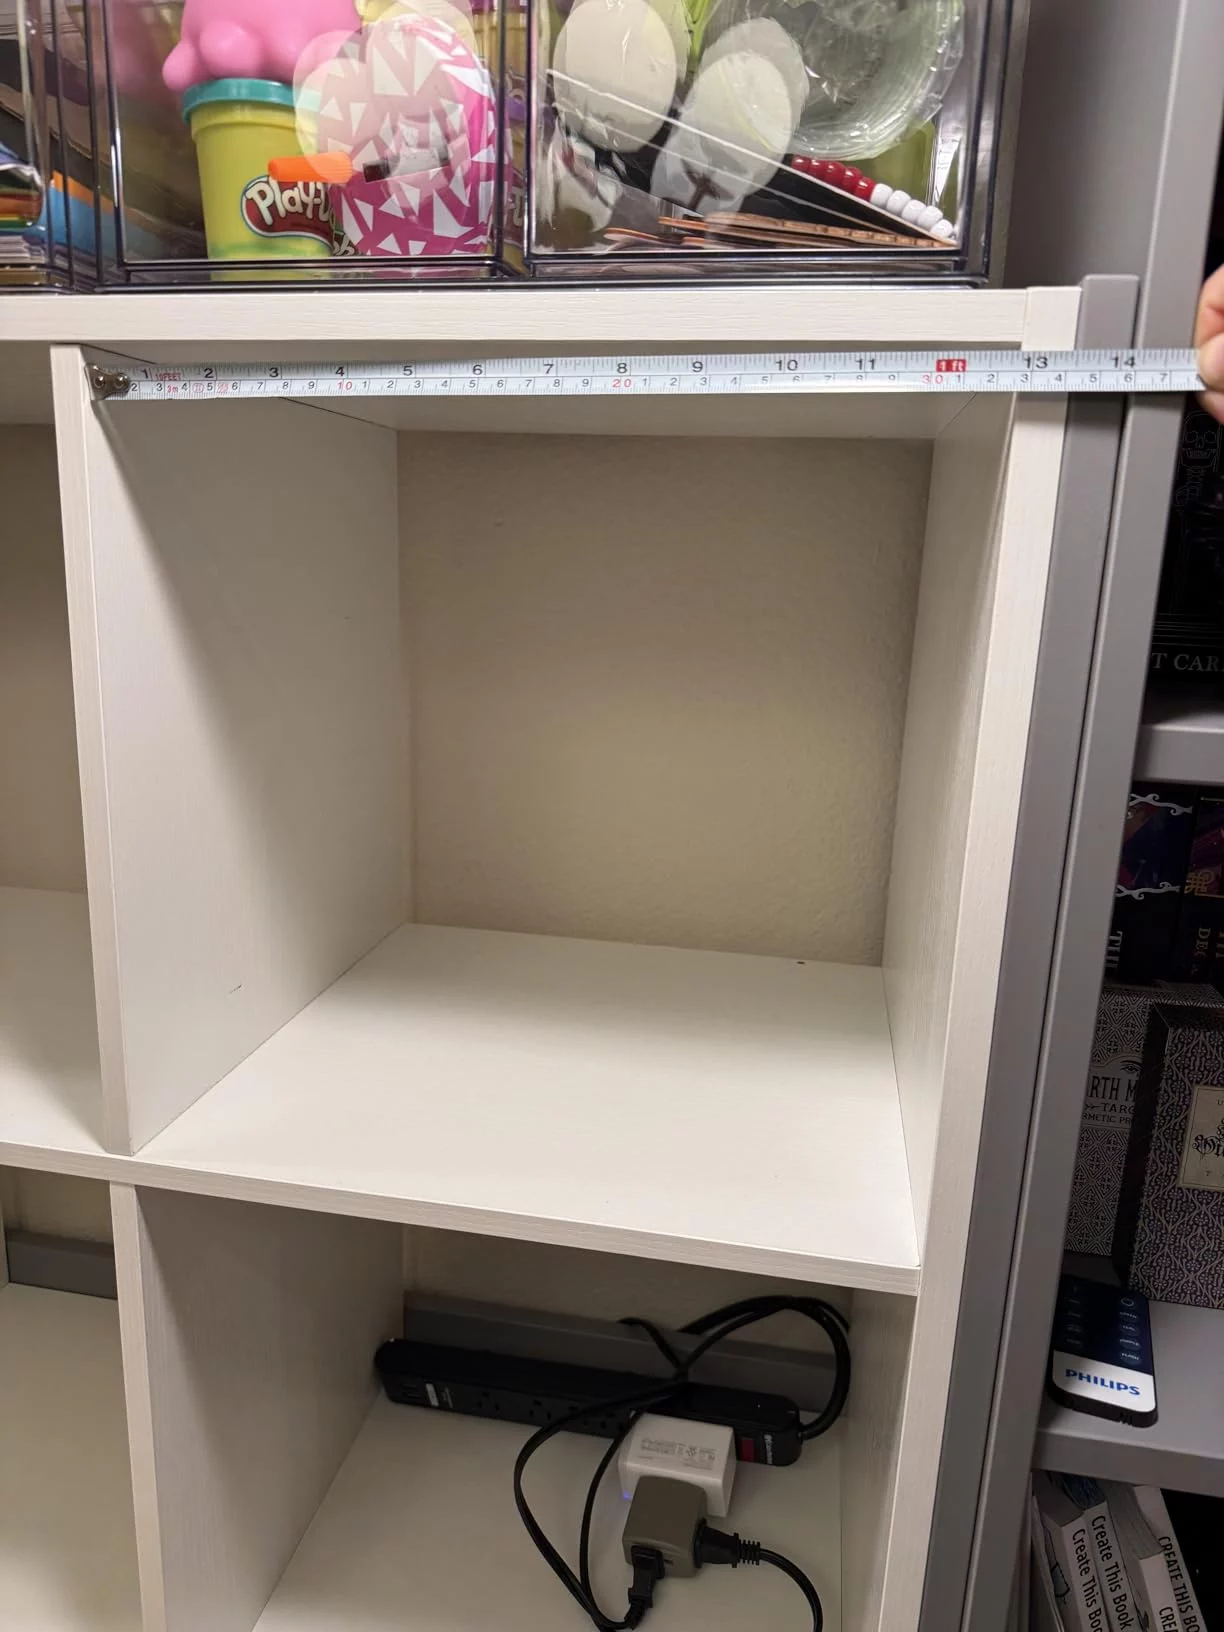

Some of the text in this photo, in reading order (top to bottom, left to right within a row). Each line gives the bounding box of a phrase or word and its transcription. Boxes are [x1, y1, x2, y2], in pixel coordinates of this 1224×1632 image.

[142, 368, 149, 379] 1
[204, 368, 214, 378] 2
[269, 367, 279, 378] 3
[335, 366, 345, 376] 4
[403, 365, 413, 376] 5
[472, 364, 483, 376] 6
[543, 363, 554, 374] 7
[616, 362, 628, 374] 8
[692, 361, 703, 372] 9
[776, 359, 798, 371] 10
[855, 358, 876, 370] 11
[1024, 356, 1048, 369] 13
[1112, 356, 1136, 368] 14
[1172, 653, 1224, 672] CAR
[1065, 1368, 1141, 1396] PHILIPS
[1072, 1528, 1091, 1577] Create
[1082, 1575, 1099, 1608] This
[1092, 1515, 1135, 1631] Create This Book
[1158, 1536, 1184, 1582] CREATE
[1173, 1582, 1194, 1614] THIS
[1159, 1606, 1179, 1632] CRE
